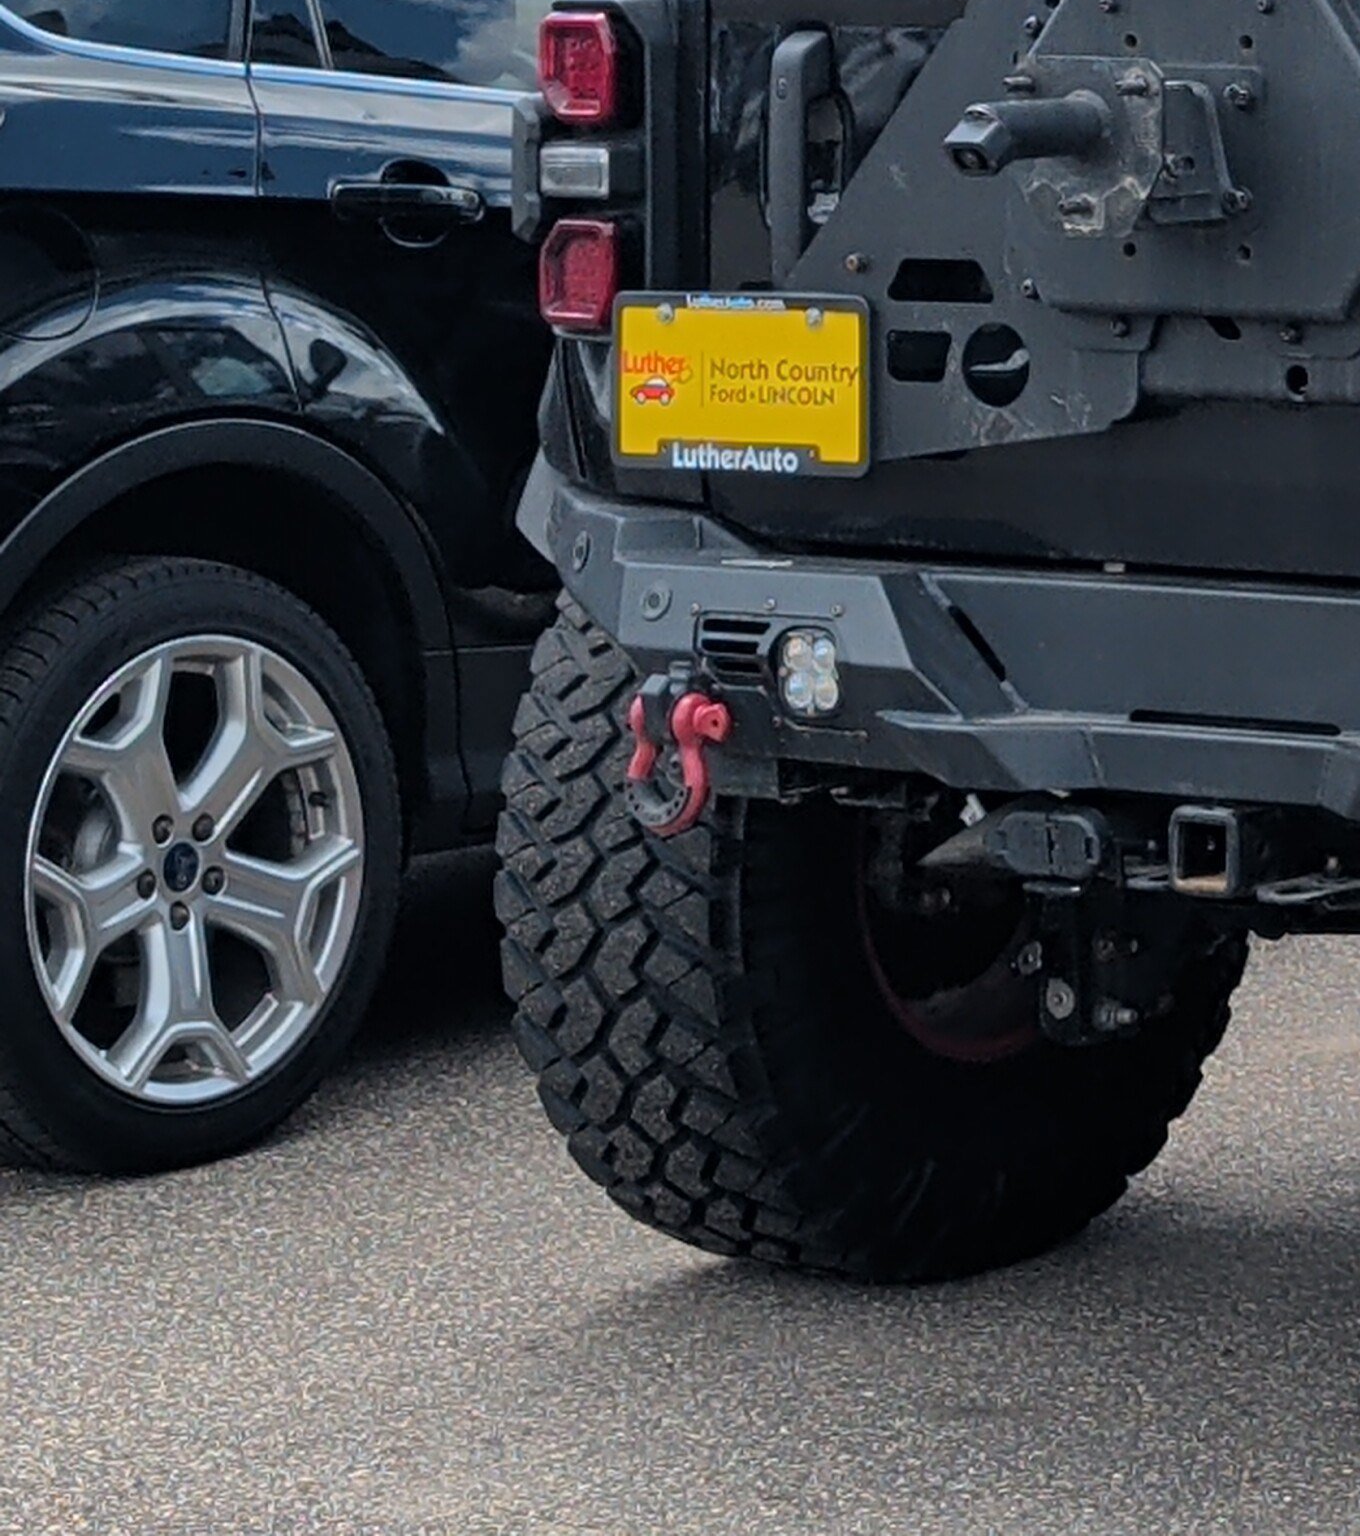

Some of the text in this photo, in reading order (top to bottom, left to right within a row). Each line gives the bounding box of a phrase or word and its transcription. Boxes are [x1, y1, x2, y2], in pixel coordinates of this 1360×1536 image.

[622, 351, 686, 375] Luther
[709, 359, 859, 387] North Country
[709, 384, 836, 406] Ford LINCOLN
[672, 441, 799, 473] LutherAuto
